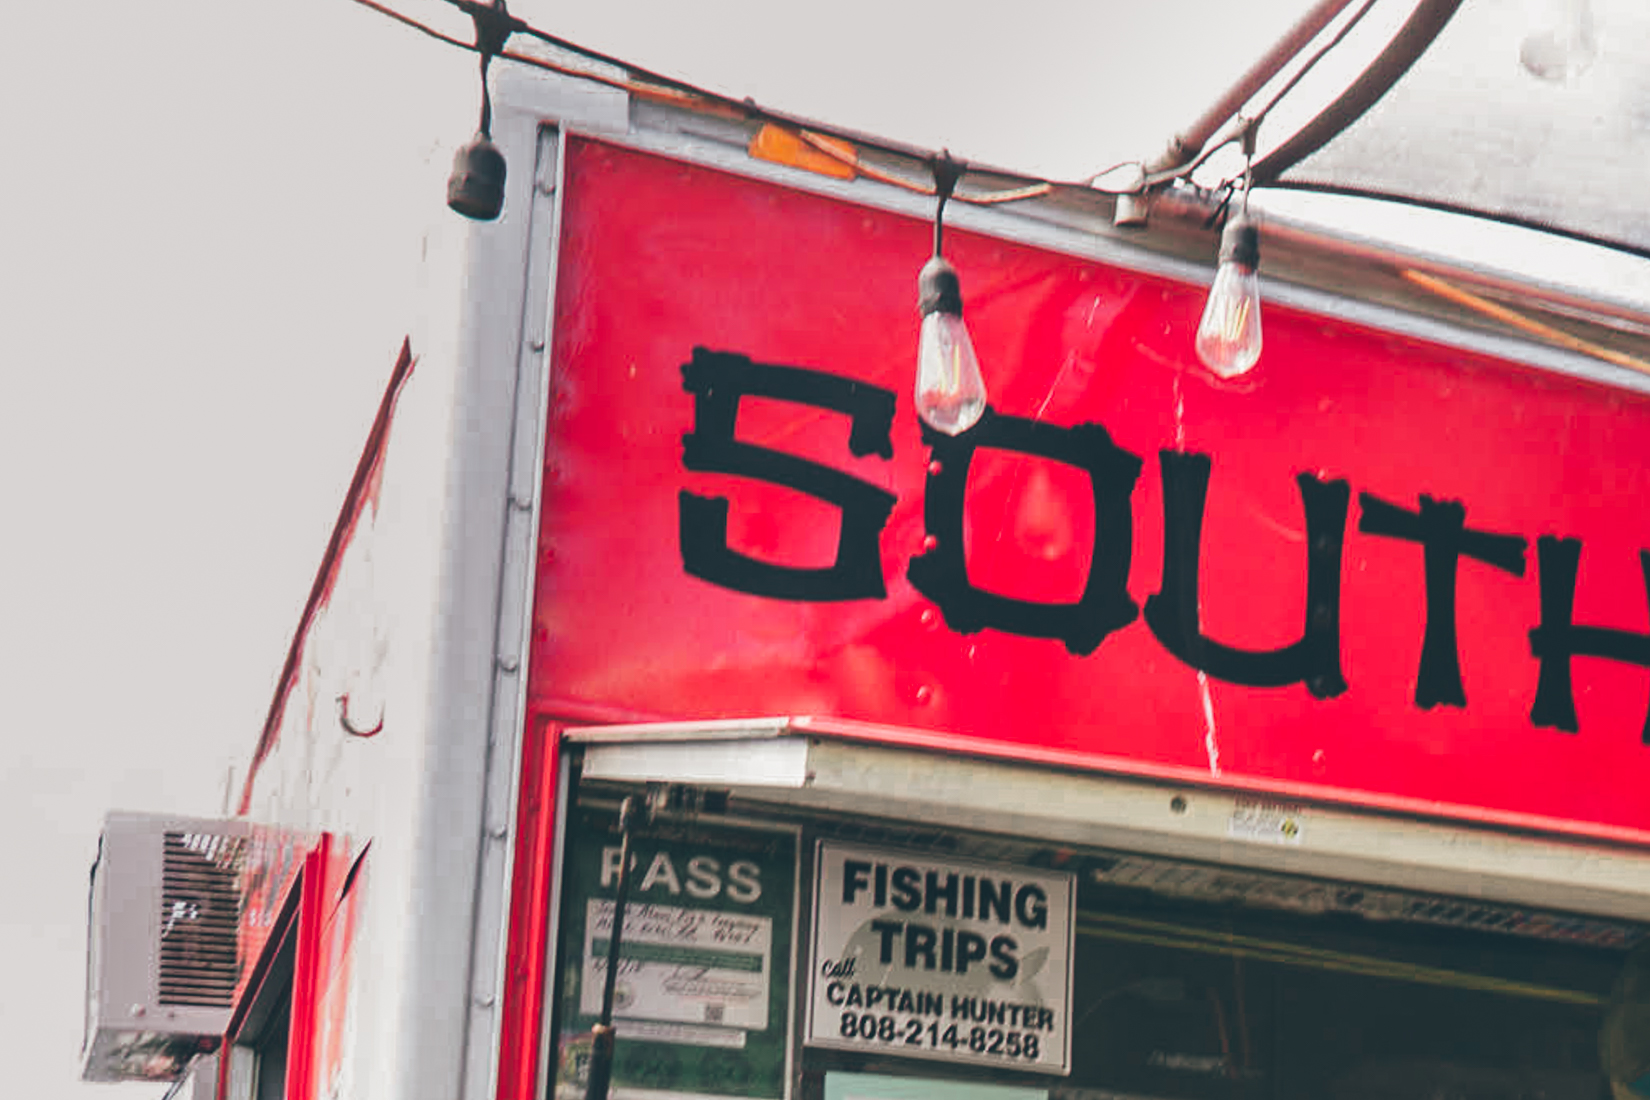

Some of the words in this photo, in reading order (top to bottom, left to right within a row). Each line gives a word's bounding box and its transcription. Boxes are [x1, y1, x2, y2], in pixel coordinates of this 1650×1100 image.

[601, 846, 762, 902] PASS
[842, 859, 1049, 931] FISHING
[871, 919, 1019, 981] TRIPS
[826, 980, 944, 1018] CAPTAIN
[951, 993, 1055, 1033] HUNTER
[840, 1011, 1040, 1060] 808-214-8258
